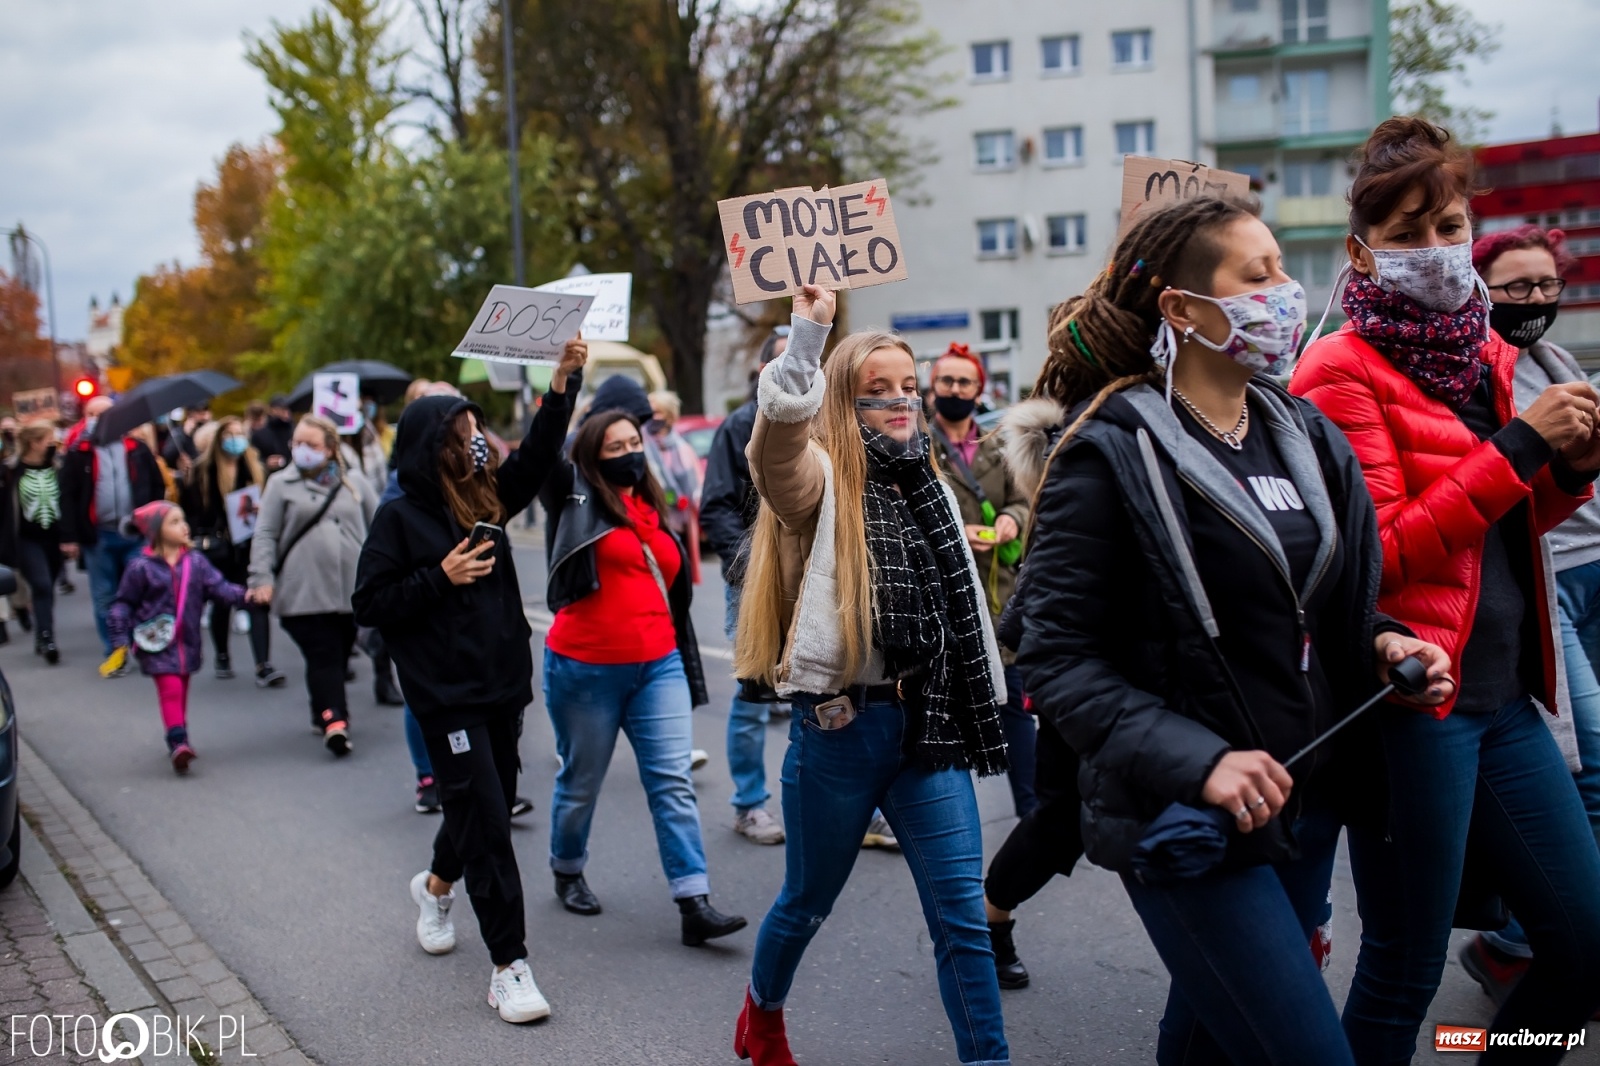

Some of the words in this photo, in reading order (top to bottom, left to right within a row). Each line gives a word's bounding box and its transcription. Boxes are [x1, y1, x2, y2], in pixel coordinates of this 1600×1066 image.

[743, 193, 874, 240] MOJE
[750, 236, 898, 292] CIAŁO
[475, 298, 584, 347] DOŚĆ
